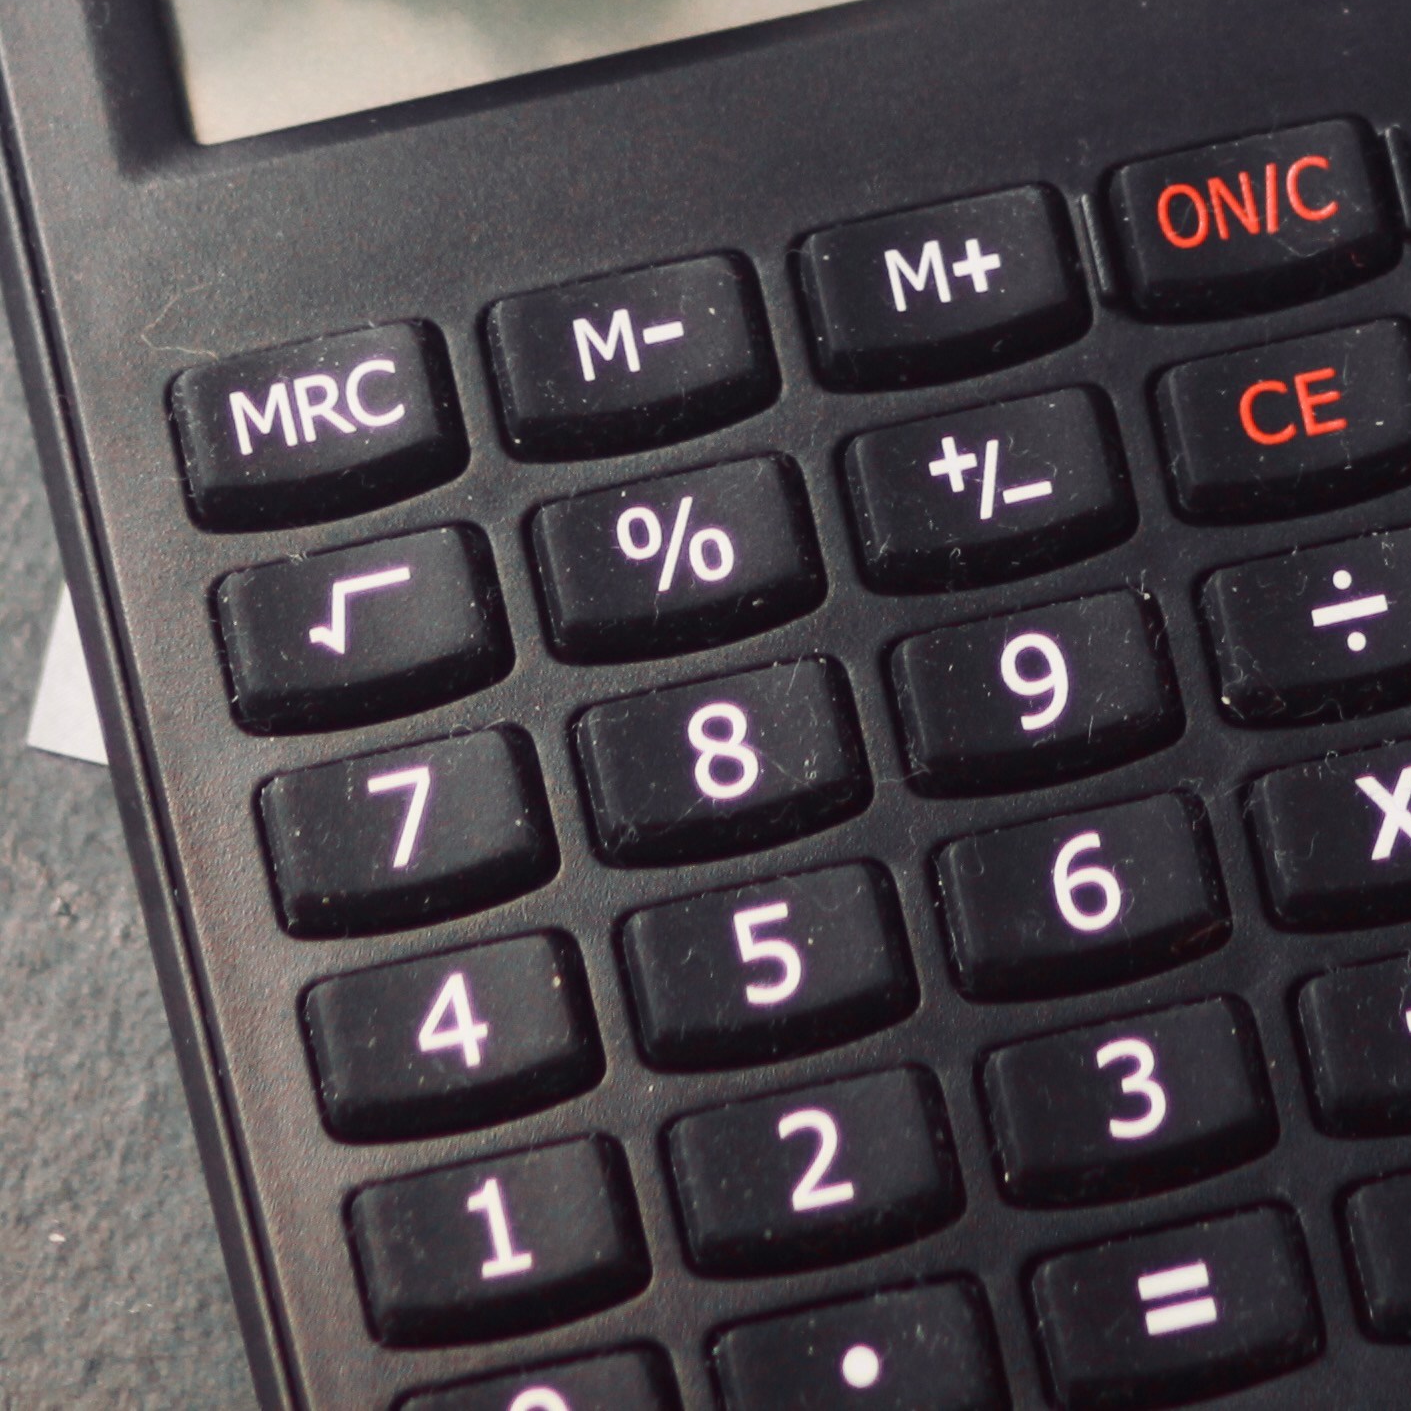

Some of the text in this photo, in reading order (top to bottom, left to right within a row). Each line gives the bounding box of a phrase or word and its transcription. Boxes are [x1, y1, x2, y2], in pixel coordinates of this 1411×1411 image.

[1157, 155, 1338, 249] ON/C
[884, 238, 1001, 312] M+
[228, 358, 406, 456] MRC
[1239, 367, 1347, 445] CE
[1000, 633, 1069, 731] 9
[687, 702, 759, 800] 8
[367, 765, 432, 869] 7
[1053, 832, 1122, 931] 6
[733, 902, 802, 1005] 5
[417, 972, 489, 1068] 4
[1096, 1038, 1167, 1139] 3
[778, 1109, 855, 1211] 2
[466, 1178, 533, 1279] 1
